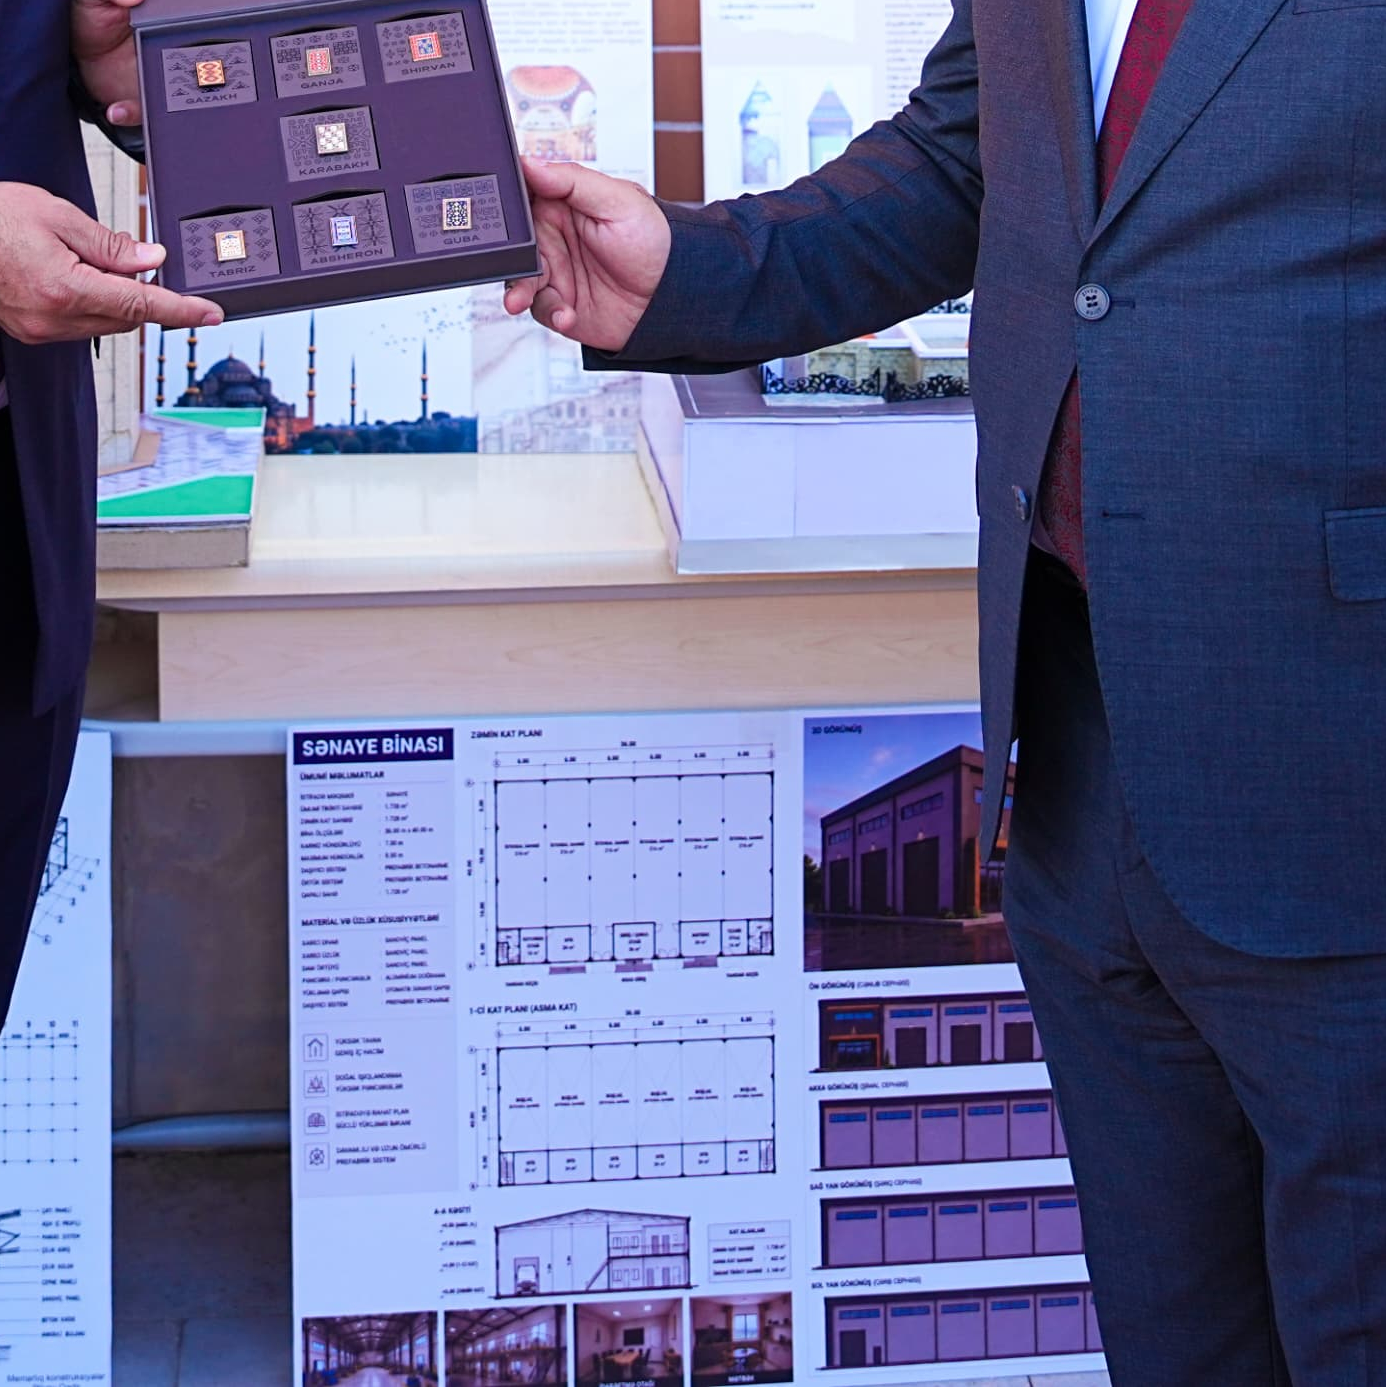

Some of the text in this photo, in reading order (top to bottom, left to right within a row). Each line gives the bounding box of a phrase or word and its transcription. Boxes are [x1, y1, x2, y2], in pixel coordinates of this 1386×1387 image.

[401, 62, 456, 76] SHIRVAN
[300, 78, 344, 90] GANJA
[298, 161, 370, 176] KARABAKH
[443, 234, 481, 246] GUBA
[310, 248, 384, 265] ABSHERON
[209, 265, 257, 279] TABRIZ
[500, 730, 516, 738] KAT
[302, 734, 443, 756] SƏNAYE BİNASI
[487, 1005, 503, 1013] KAT
[505, 1004, 528, 1013] PLANI
